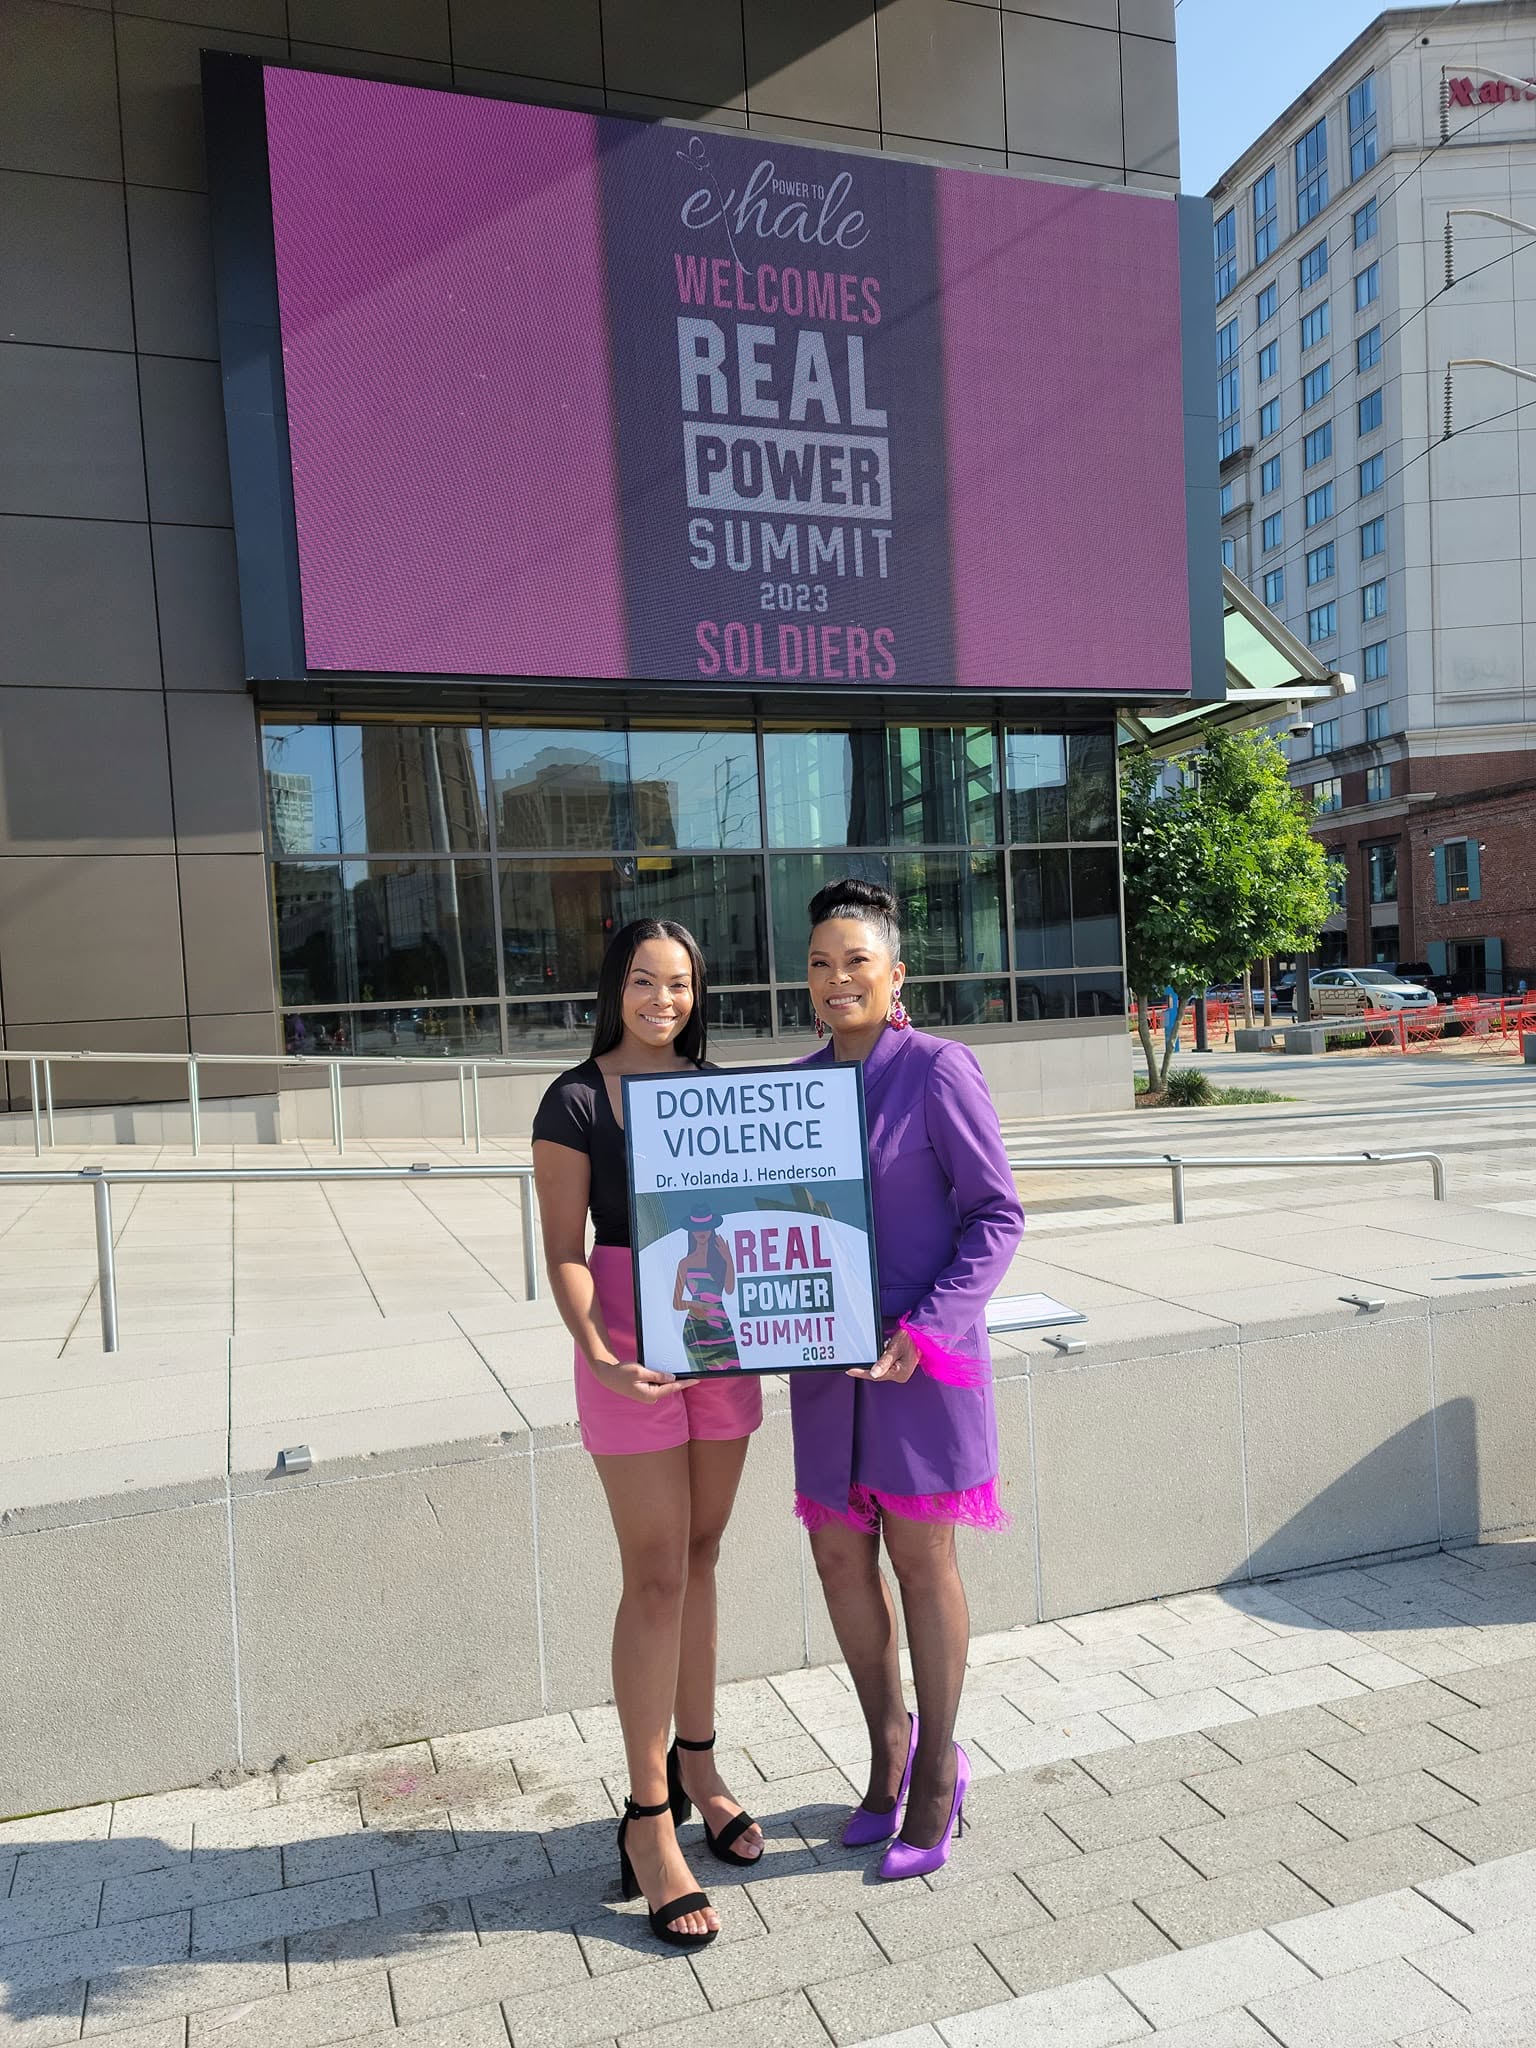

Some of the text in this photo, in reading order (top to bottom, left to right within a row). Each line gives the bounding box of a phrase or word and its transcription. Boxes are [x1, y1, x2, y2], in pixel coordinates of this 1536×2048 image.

[680, 159, 871, 249] exhale
[771, 178, 825, 200] POWER TO
[674, 252, 882, 325] WELCOMES
[677, 316, 888, 428] REAL
[695, 434, 882, 508] POWER
[688, 517, 893, 578] SUMMIT
[759, 581, 829, 612] 2023
[695, 620, 897, 680] SOLDIERS
[656, 1080, 826, 1119] DOMESTIC
[663, 1119, 823, 1158] VIOLENCE
[656, 1164, 837, 1188] Dr. Yolanda J. Henderson
[734, 1225, 832, 1273] REAL
[742, 1278, 830, 1312] POWER
[739, 1316, 836, 1347] SUMMIT
[802, 1346, 836, 1361] 2023
